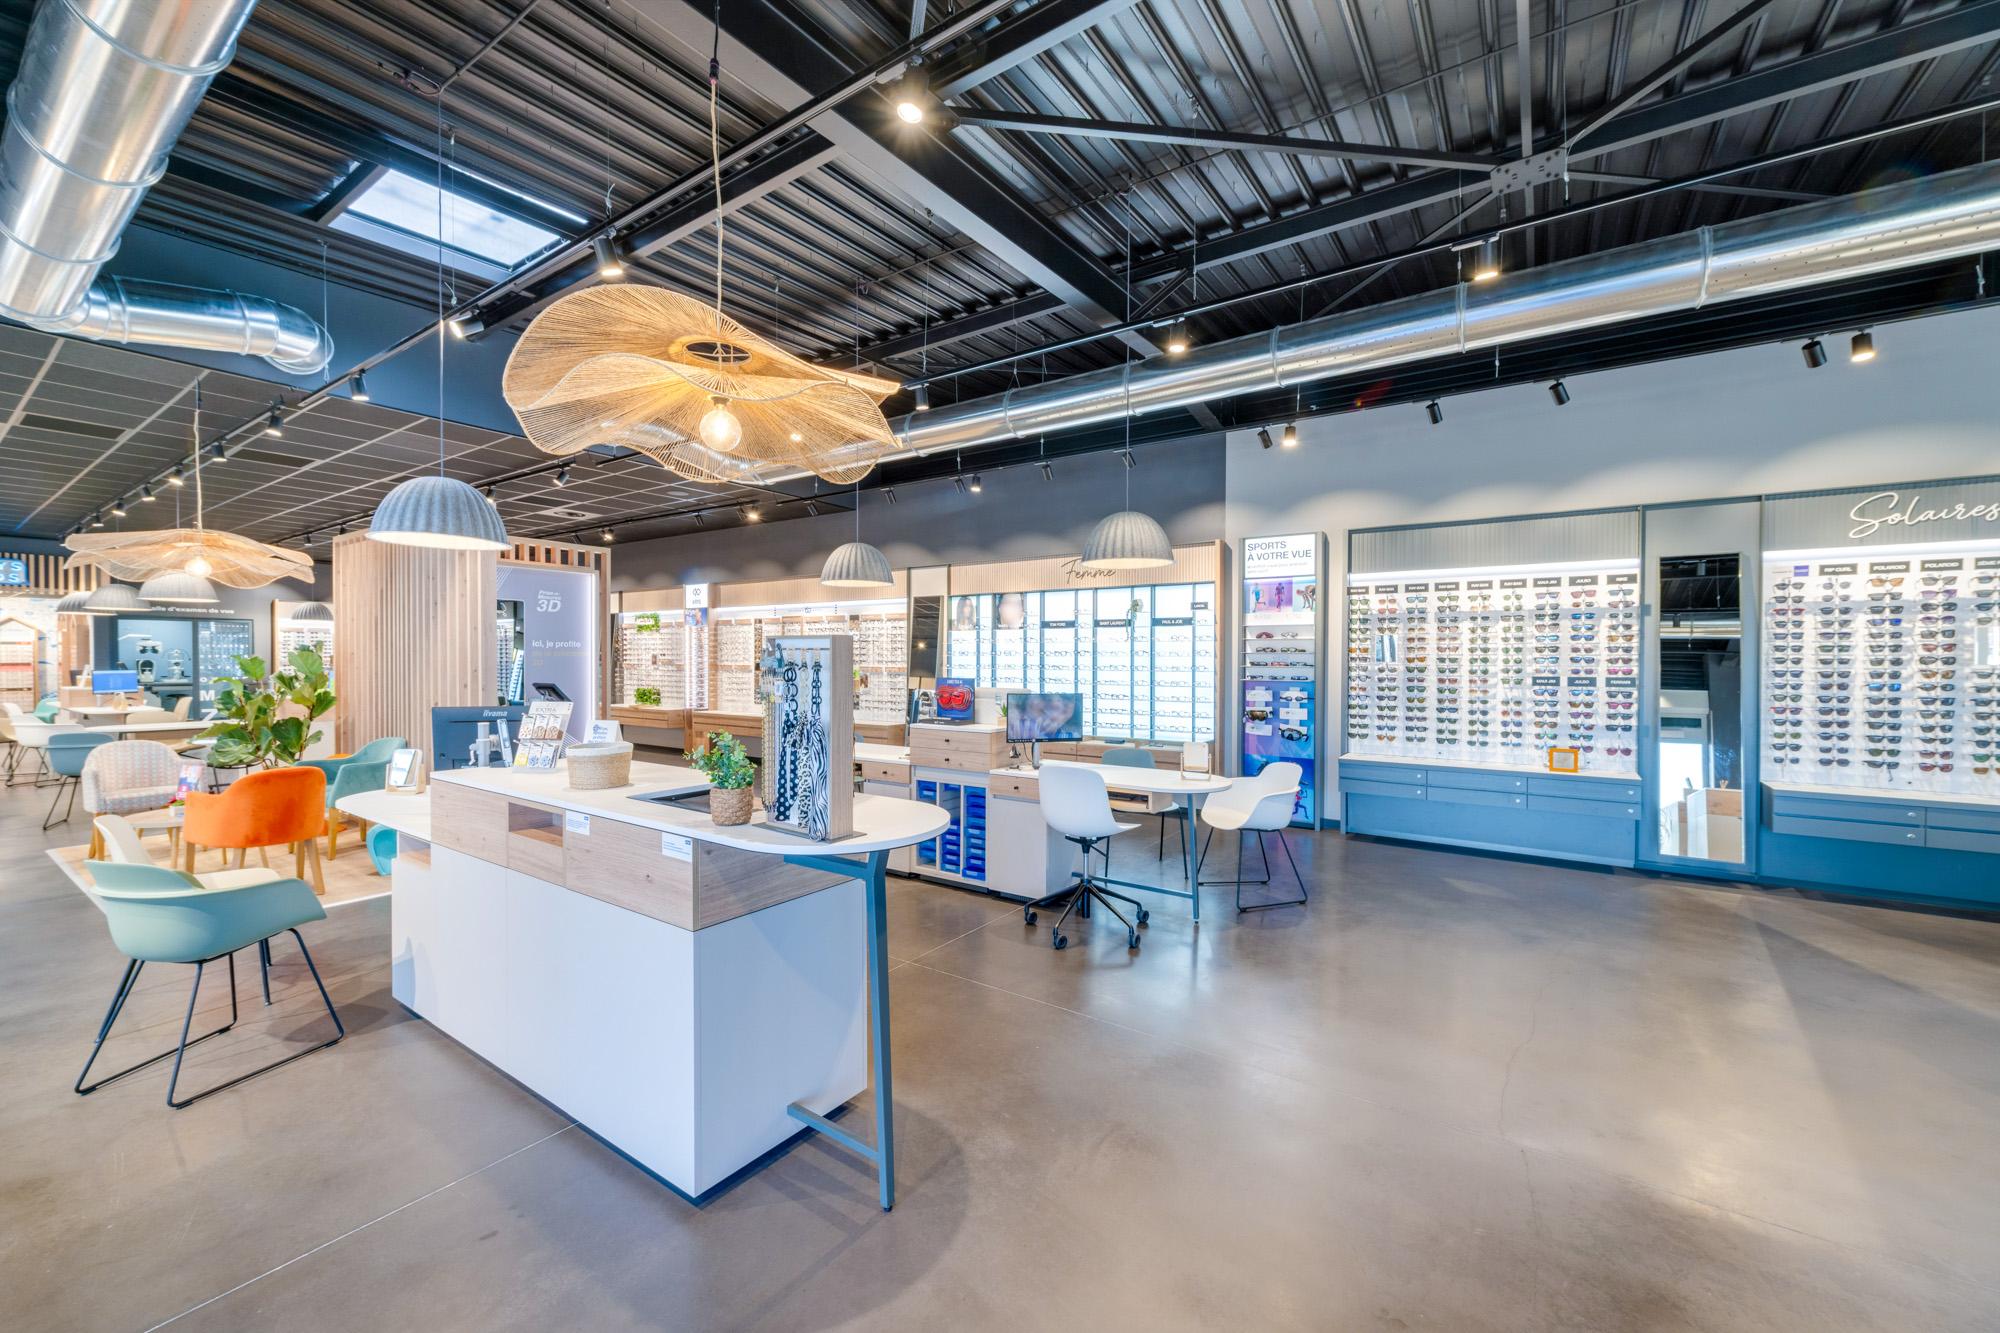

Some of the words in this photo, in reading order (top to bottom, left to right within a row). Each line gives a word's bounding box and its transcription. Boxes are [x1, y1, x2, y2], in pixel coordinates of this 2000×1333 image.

[1849, 491, 2000, 538] Solaires
[1247, 540, 1287, 551] SPORTS
[1247, 552, 1254, 561] À
[1256, 551, 1289, 561] VOTRE
[1291, 549, 1312, 558] VUE
[1061, 558, 1116, 584] Femme
[536, 600, 561, 612] 3D
[200, 690, 215, 701] M
